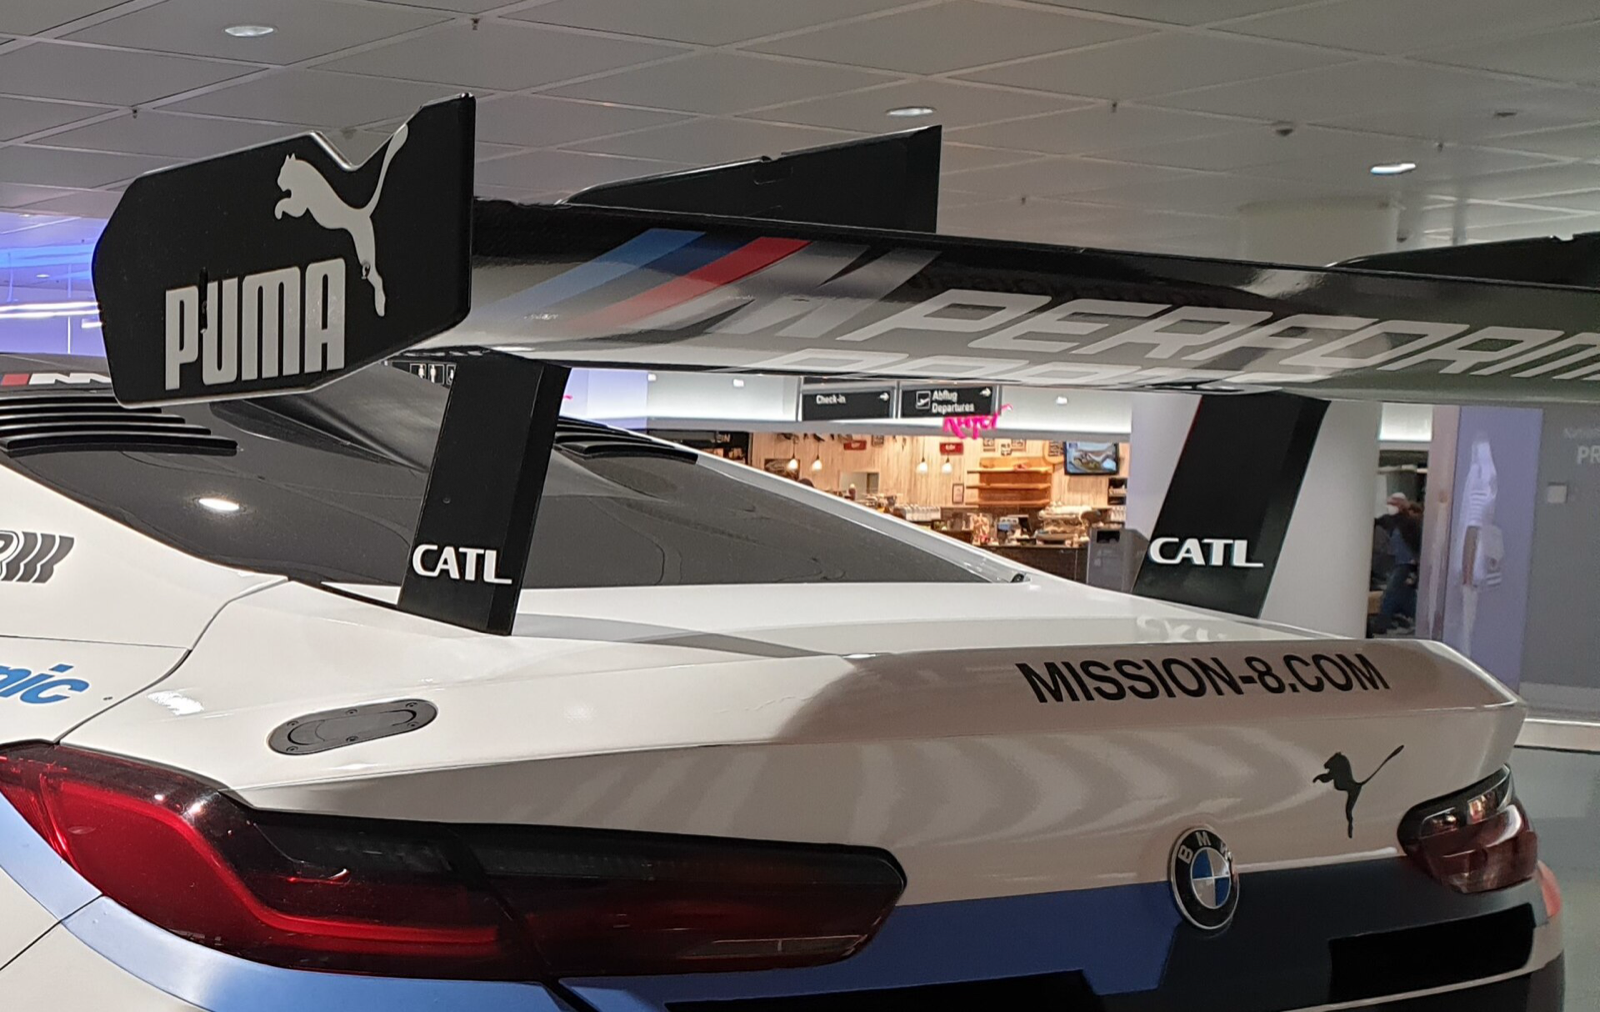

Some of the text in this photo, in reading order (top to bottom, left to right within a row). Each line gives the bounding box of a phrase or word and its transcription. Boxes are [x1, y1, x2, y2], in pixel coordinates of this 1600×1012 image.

[165, 257, 346, 391] PUMA
[816, 394, 846, 405] Check-in
[932, 390, 957, 403] Abflug
[932, 402, 974, 414] Departures
[412, 543, 512, 584] CATL
[1150, 537, 1264, 567] CATL
[1015, 653, 1390, 703] MISSION-8.COM
[1178, 830, 1232, 864] BMW
